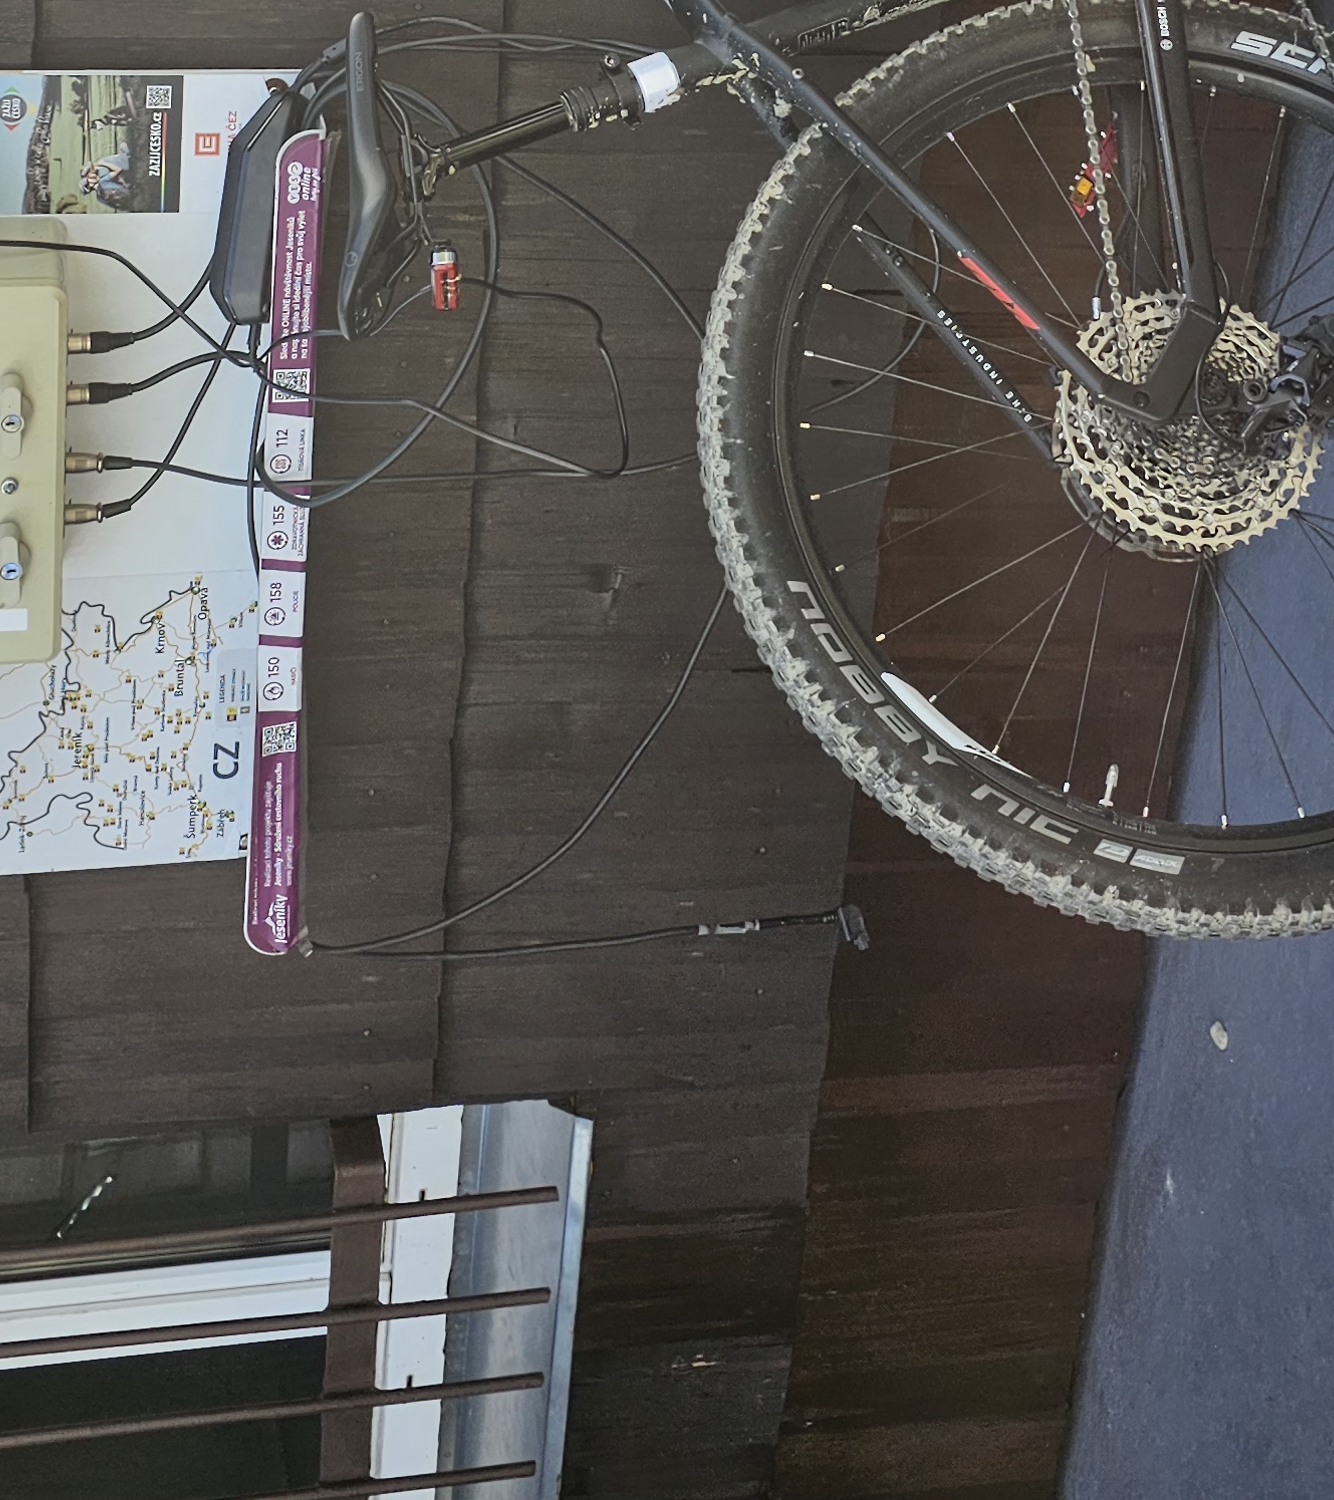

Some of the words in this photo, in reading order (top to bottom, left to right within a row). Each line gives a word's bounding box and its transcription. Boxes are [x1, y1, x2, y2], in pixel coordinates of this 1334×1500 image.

[1156, 6, 1170, 37] BOSCH
[354, 51, 365, 92] ERGON
[0, 99, 11, 119] ZAŽIJ
[10, 98, 21, 119] ČESKO
[227, 110, 238, 132] ČEZ
[148, 111, 163, 177] ZAZIJCESKO.cz
[287, 174, 299, 204] YES
[300, 166, 312, 201] online
[295, 210, 306, 230] výlet
[294, 230, 306, 247] svůj
[294, 261, 304, 276] čas
[296, 248, 305, 261] pro
[304, 261, 313, 285] místa.
[293, 276, 303, 303] ideální
[281, 298, 291, 327] ONLINE
[302, 285, 313, 335] ejoblíbenější
[279, 326, 290, 360] Sledte
[302, 348, 309, 359] na
[275, 428, 288, 449] 112
[298, 428, 306, 447] LINKA
[272, 504, 285, 526] 155
[197, 587, 209, 620] Opava
[269, 582, 282, 603] 158
[292, 590, 300, 613] POLICIE
[154, 622, 166, 654] Krnov
[173, 659, 184, 697] Bruntál
[268, 656, 280, 678] 150
[786, 580, 959, 767] NOBBY
[218, 674, 226, 703] LEGENDA
[212, 741, 240, 780] CZ
[275, 762, 284, 784] ruchu
[183, 793, 198, 839] Šumperk
[274, 783, 284, 821] cestovního
[970, 782, 1079, 845] NIC
[216, 809, 225, 838] Zábřeh
[264, 809, 273, 836] projektu
[273, 821, 283, 853] Sdružení
[264, 836, 272, 860] tohoto
[273, 857, 284, 887] Jeseníky
[272, 893, 289, 944] Jeseníky
